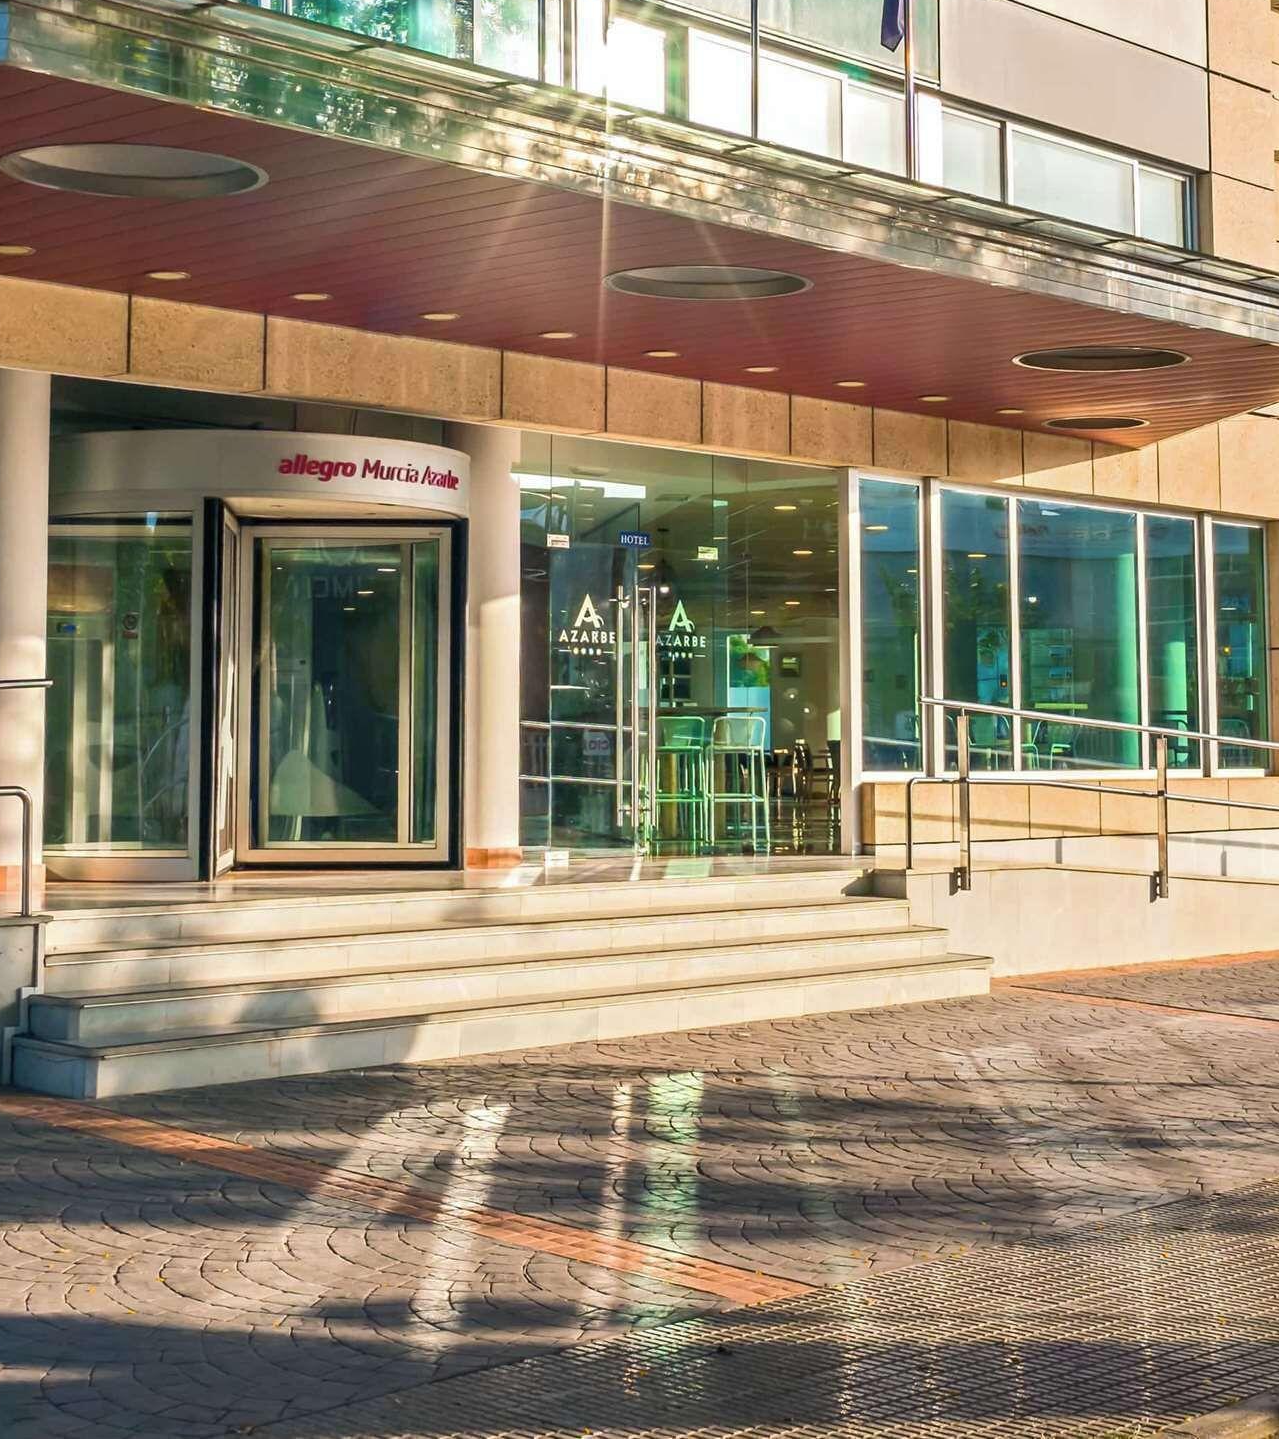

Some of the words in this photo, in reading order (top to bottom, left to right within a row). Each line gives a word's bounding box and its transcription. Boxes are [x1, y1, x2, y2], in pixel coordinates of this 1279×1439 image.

[278, 453, 357, 482] allegro
[361, 458, 419, 484] Murcia
[420, 465, 460, 491] Azarbe
[620, 534, 650, 546] HOTEL
[558, 629, 616, 644] AZARBE
[656, 634, 706, 648] AZARBE
